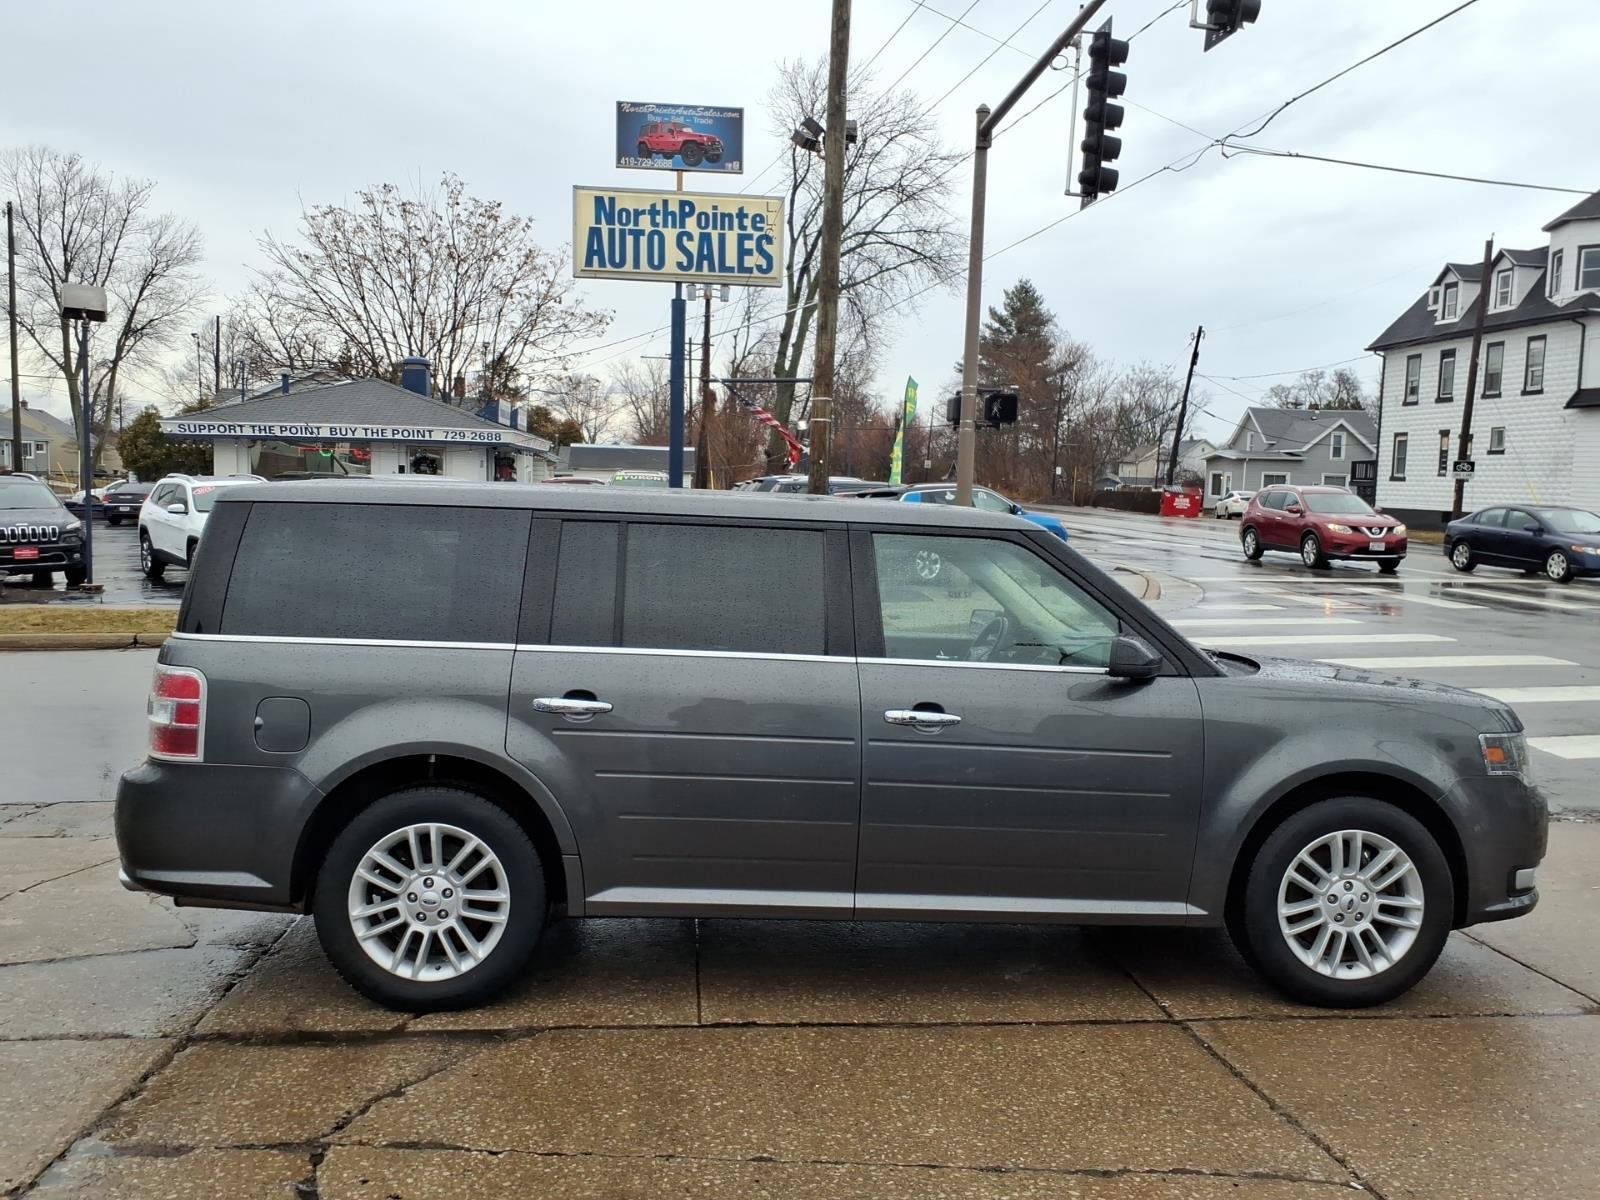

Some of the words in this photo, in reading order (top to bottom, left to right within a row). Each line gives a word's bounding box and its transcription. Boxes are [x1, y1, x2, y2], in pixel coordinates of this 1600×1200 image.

[693, 116, 713, 124] Trade
[620, 156, 673, 168] 419-729-2688
[594, 195, 766, 232] NorthPointe
[584, 226, 665, 272] AUTO
[675, 230, 774, 275] SALES
[178, 423, 245, 434] SUPPORT
[249, 425, 276, 435] THE
[279, 426, 322, 436] POINT
[329, 427, 358, 437] BUY
[361, 427, 388, 438] THE
[391, 428, 434, 439] POINT
[443, 430, 502, 442] 729-2688
